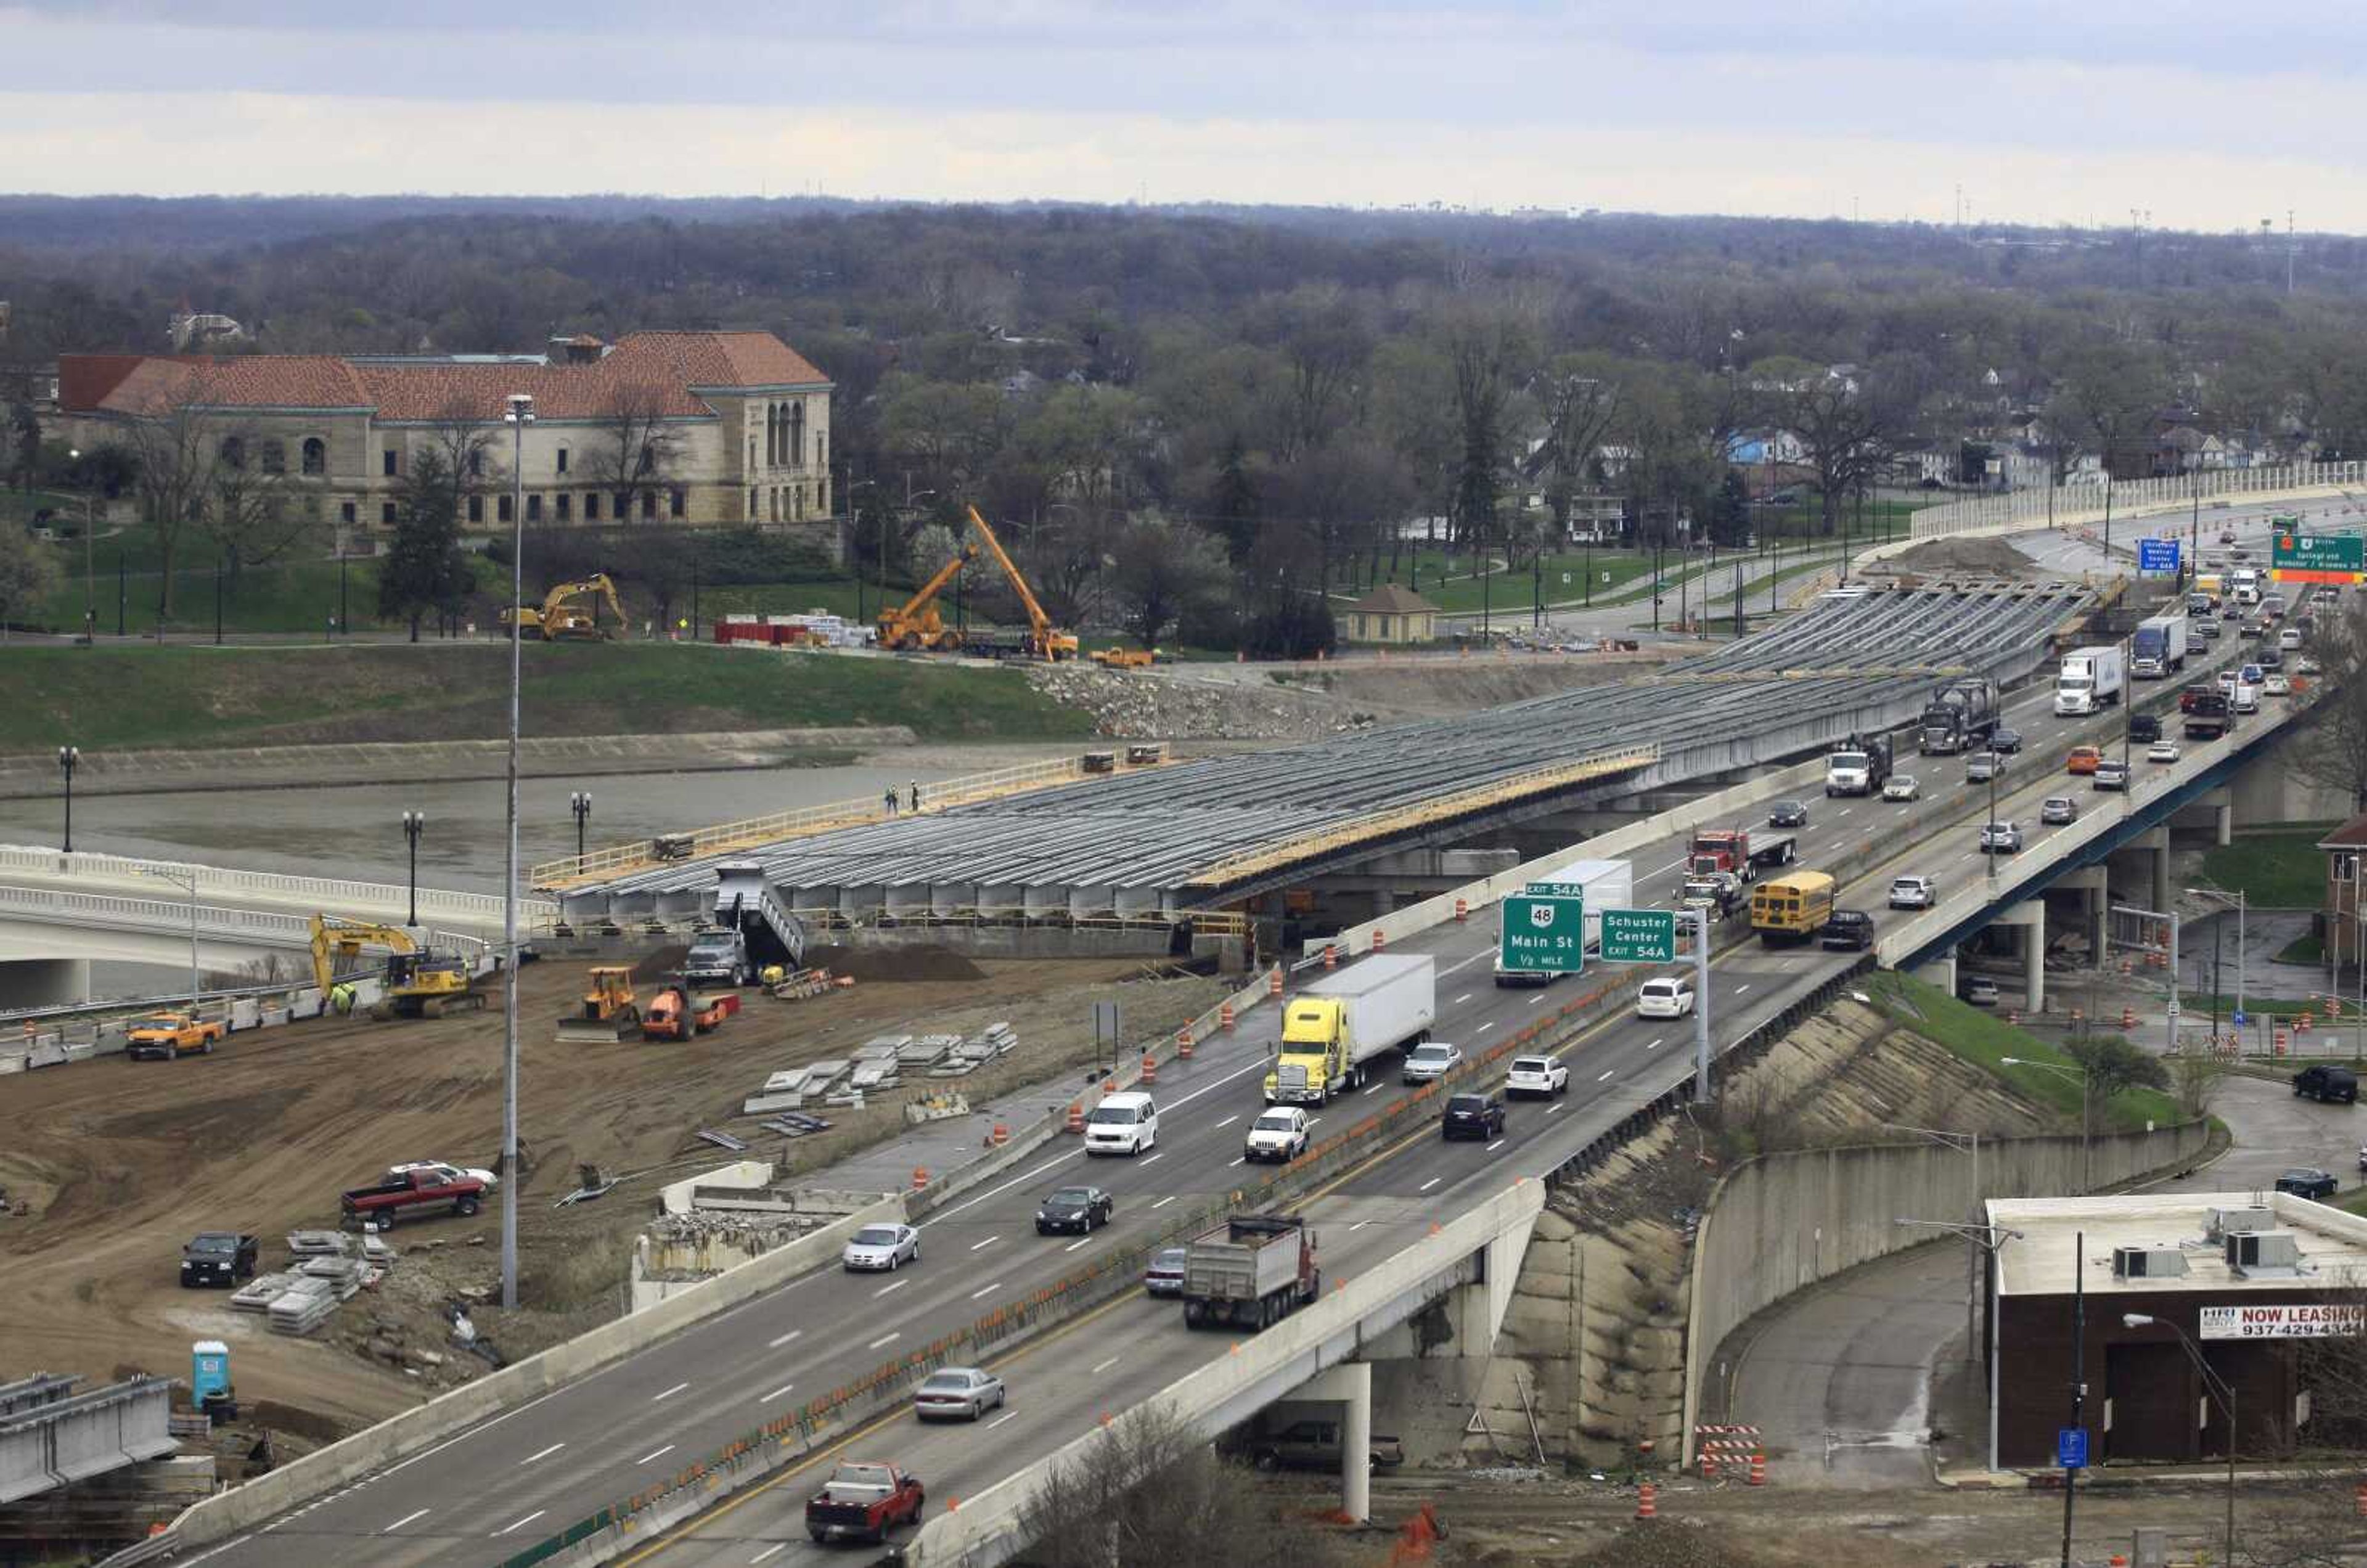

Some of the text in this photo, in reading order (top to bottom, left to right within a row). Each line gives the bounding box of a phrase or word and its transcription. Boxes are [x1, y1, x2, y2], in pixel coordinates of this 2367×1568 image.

[1553, 884, 1581, 896] 54A
[1534, 909, 1551, 921] 48
[1608, 916, 1667, 927] Schuster
[1511, 935, 1572, 947] Main St
[1616, 931, 1659, 942] Center
[1608, 946, 1666, 957] EXIT 54A
[1541, 955, 1563, 966] MILE
[2242, 1309, 2282, 1323] NOW
[2289, 1307, 2366, 1322] LEASING
